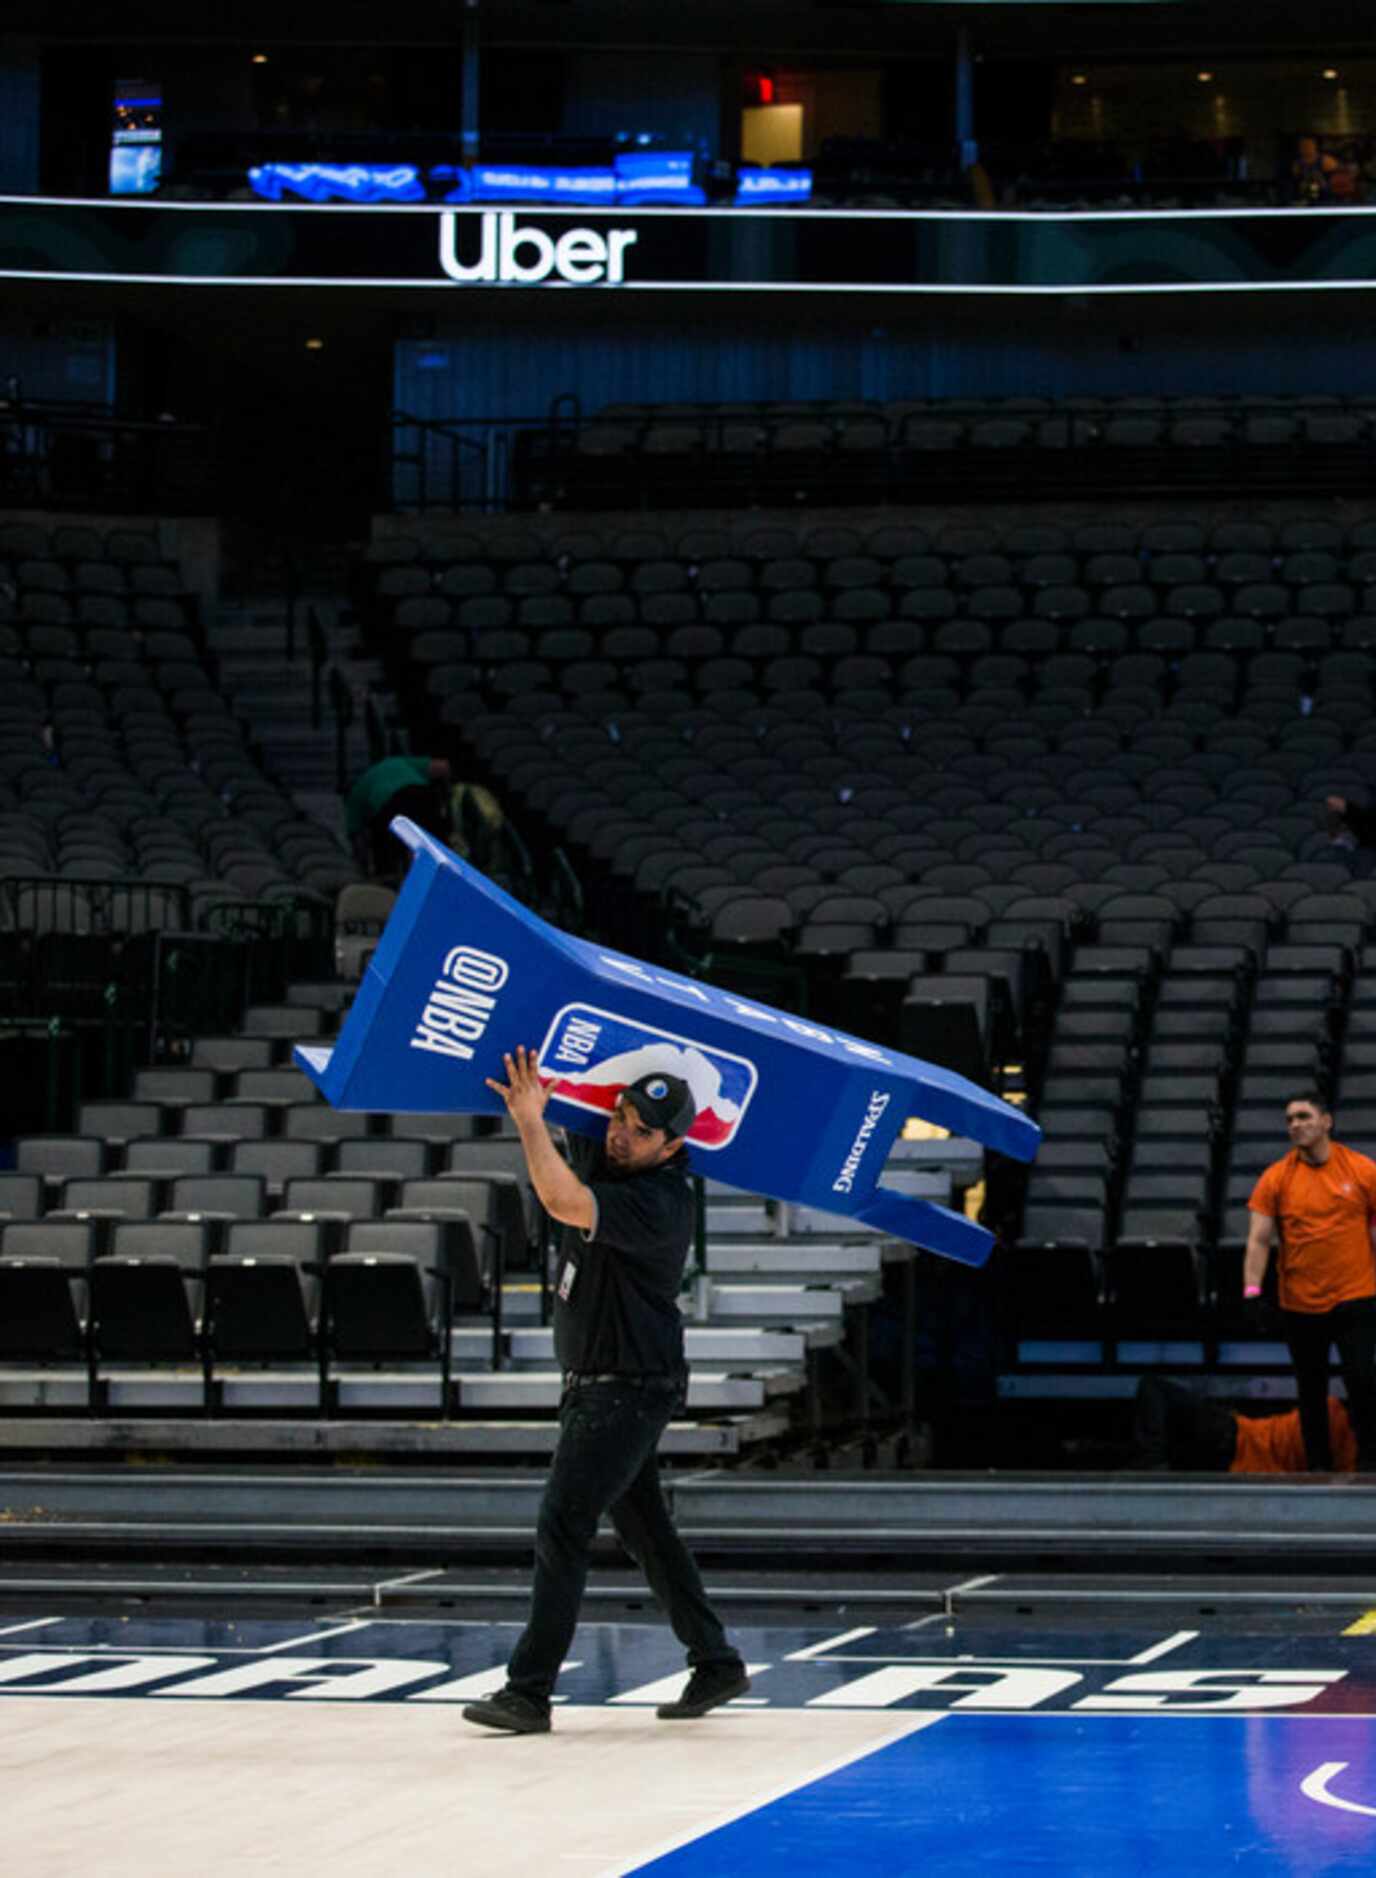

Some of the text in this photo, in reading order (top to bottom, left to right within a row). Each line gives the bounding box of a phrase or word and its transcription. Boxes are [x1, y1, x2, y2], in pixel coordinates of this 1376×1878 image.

[439, 210, 637, 284] Uber
[411, 945, 509, 1060] @NBA
[555, 1017, 602, 1066] NBA
[832, 1090, 891, 1195] SPALDING
